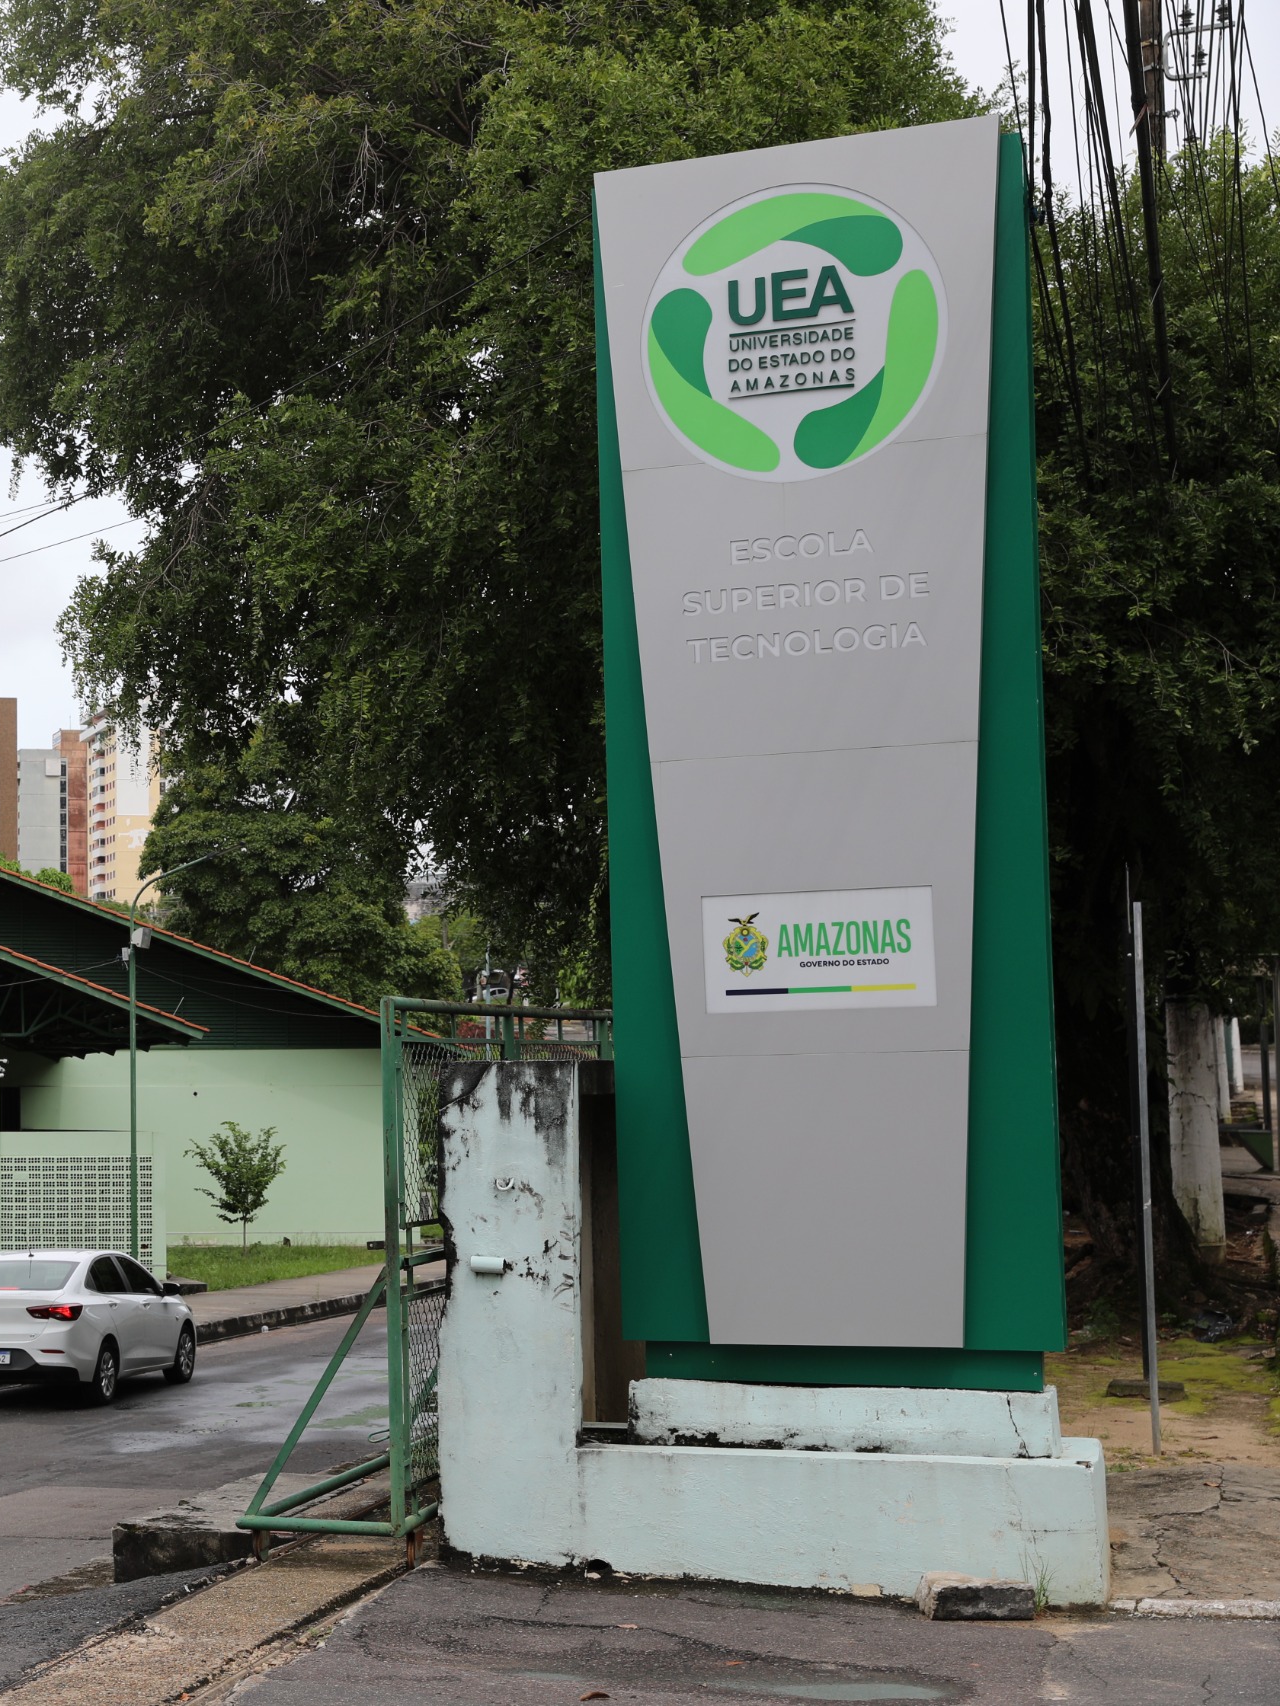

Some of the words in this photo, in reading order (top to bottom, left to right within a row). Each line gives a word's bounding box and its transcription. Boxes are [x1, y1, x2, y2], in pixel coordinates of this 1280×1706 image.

[727, 264, 855, 326] UEA
[728, 326, 855, 353] UNIVERSIDADE
[728, 357, 753, 373] DO
[758, 349, 825, 370] ESTADO
[831, 346, 856, 362] DO
[730, 367, 856, 393] AMAZONAS
[729, 528, 875, 566] ESCOLA
[682, 577, 868, 617] SUPERIOR
[878, 571, 930, 601] DE
[686, 621, 928, 664] TECNOLOGIA
[776, 918, 912, 958] AMAZONAS
[799, 959, 841, 968] GOVERNO
[842, 958, 855, 967] DO
[856, 957, 890, 966] ESTADO
